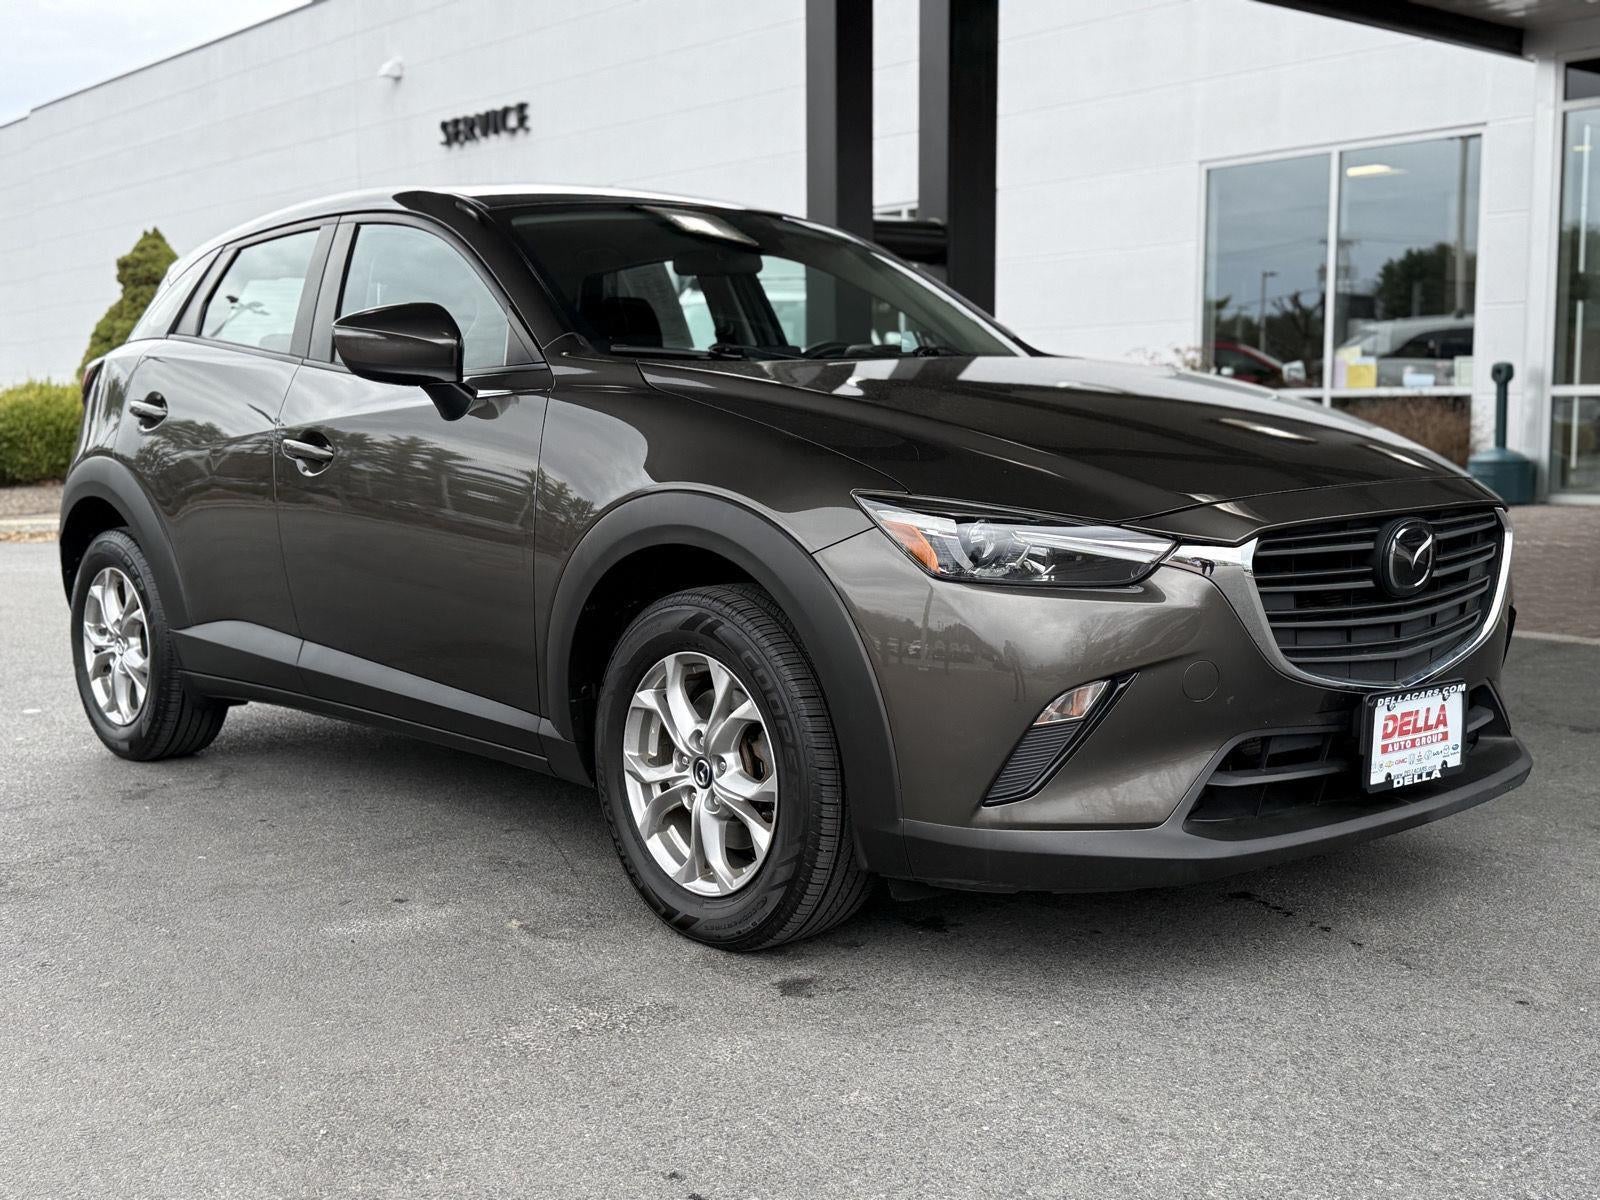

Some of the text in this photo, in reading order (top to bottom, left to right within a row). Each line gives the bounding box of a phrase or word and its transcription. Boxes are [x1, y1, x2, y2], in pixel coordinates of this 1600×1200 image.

[440, 102, 529, 147] SERVICE
[1377, 683, 1466, 707] DELLACARS.COM
[1381, 703, 1448, 740] DELLA
[1387, 732, 1443, 753] AUTO GROUP
[1393, 769, 1441, 789] DELLA
